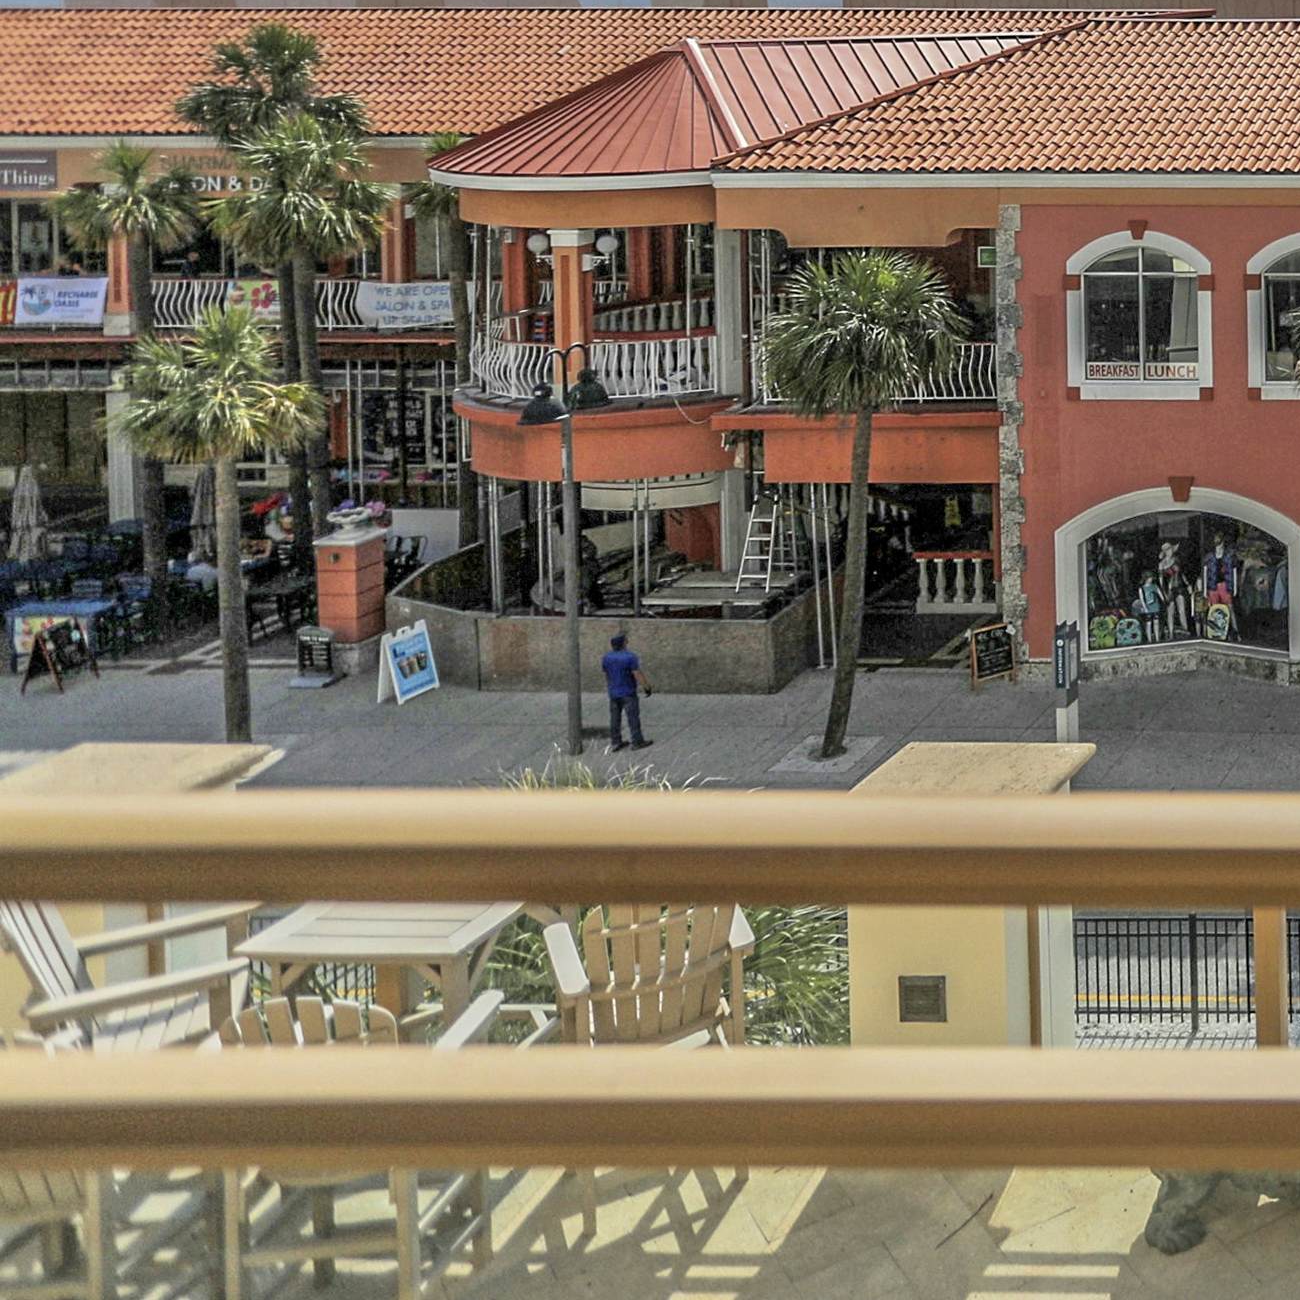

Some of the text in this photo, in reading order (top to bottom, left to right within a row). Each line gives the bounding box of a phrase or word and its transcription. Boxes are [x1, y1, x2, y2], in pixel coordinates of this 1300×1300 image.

[0, 169, 56, 188] Things
[228, 175, 242, 192] &
[375, 285, 450, 297] WE ARE OPE
[375, 301, 414, 312] SALON
[417, 301, 427, 311] &
[1088, 364, 1196, 378] BREAKFAST LUNCH
